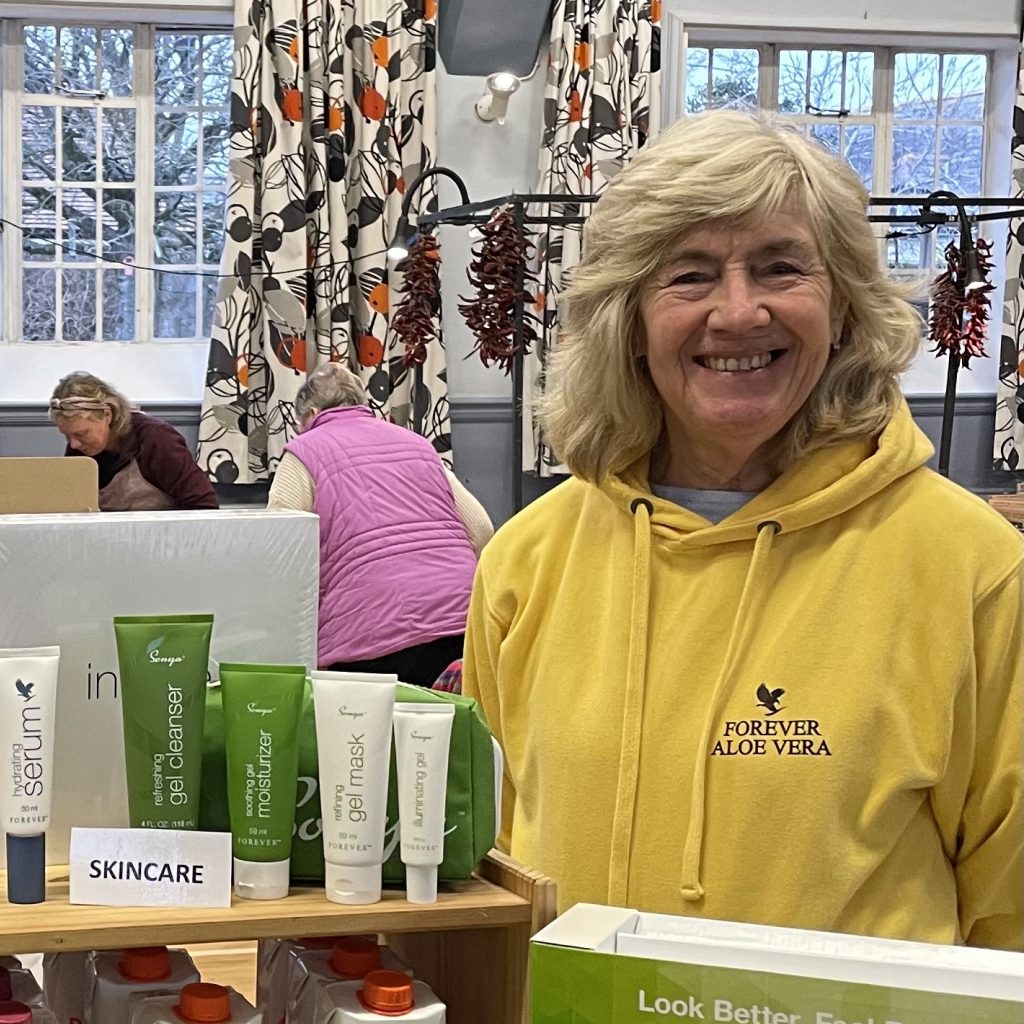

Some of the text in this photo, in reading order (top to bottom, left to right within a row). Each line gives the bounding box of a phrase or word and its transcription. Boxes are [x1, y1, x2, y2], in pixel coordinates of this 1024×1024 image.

[149, 650, 182, 667] Sonya
[22, 706, 43, 797] serum
[165, 684, 187, 806] gel cleanser
[711, 739, 832, 756] ALOE VERA
[724, 720, 822, 737] FOREVER
[12, 743, 23, 797] hydrating
[153, 754, 165, 806] refreshing
[257, 729, 273, 818] moisturizer
[346, 733, 367, 822] gel mask
[335, 785, 343, 821] refining
[414, 770, 426, 827] illuminating
[89, 859, 203, 884] SKINCARE
[638, 989, 704, 1019] Look
